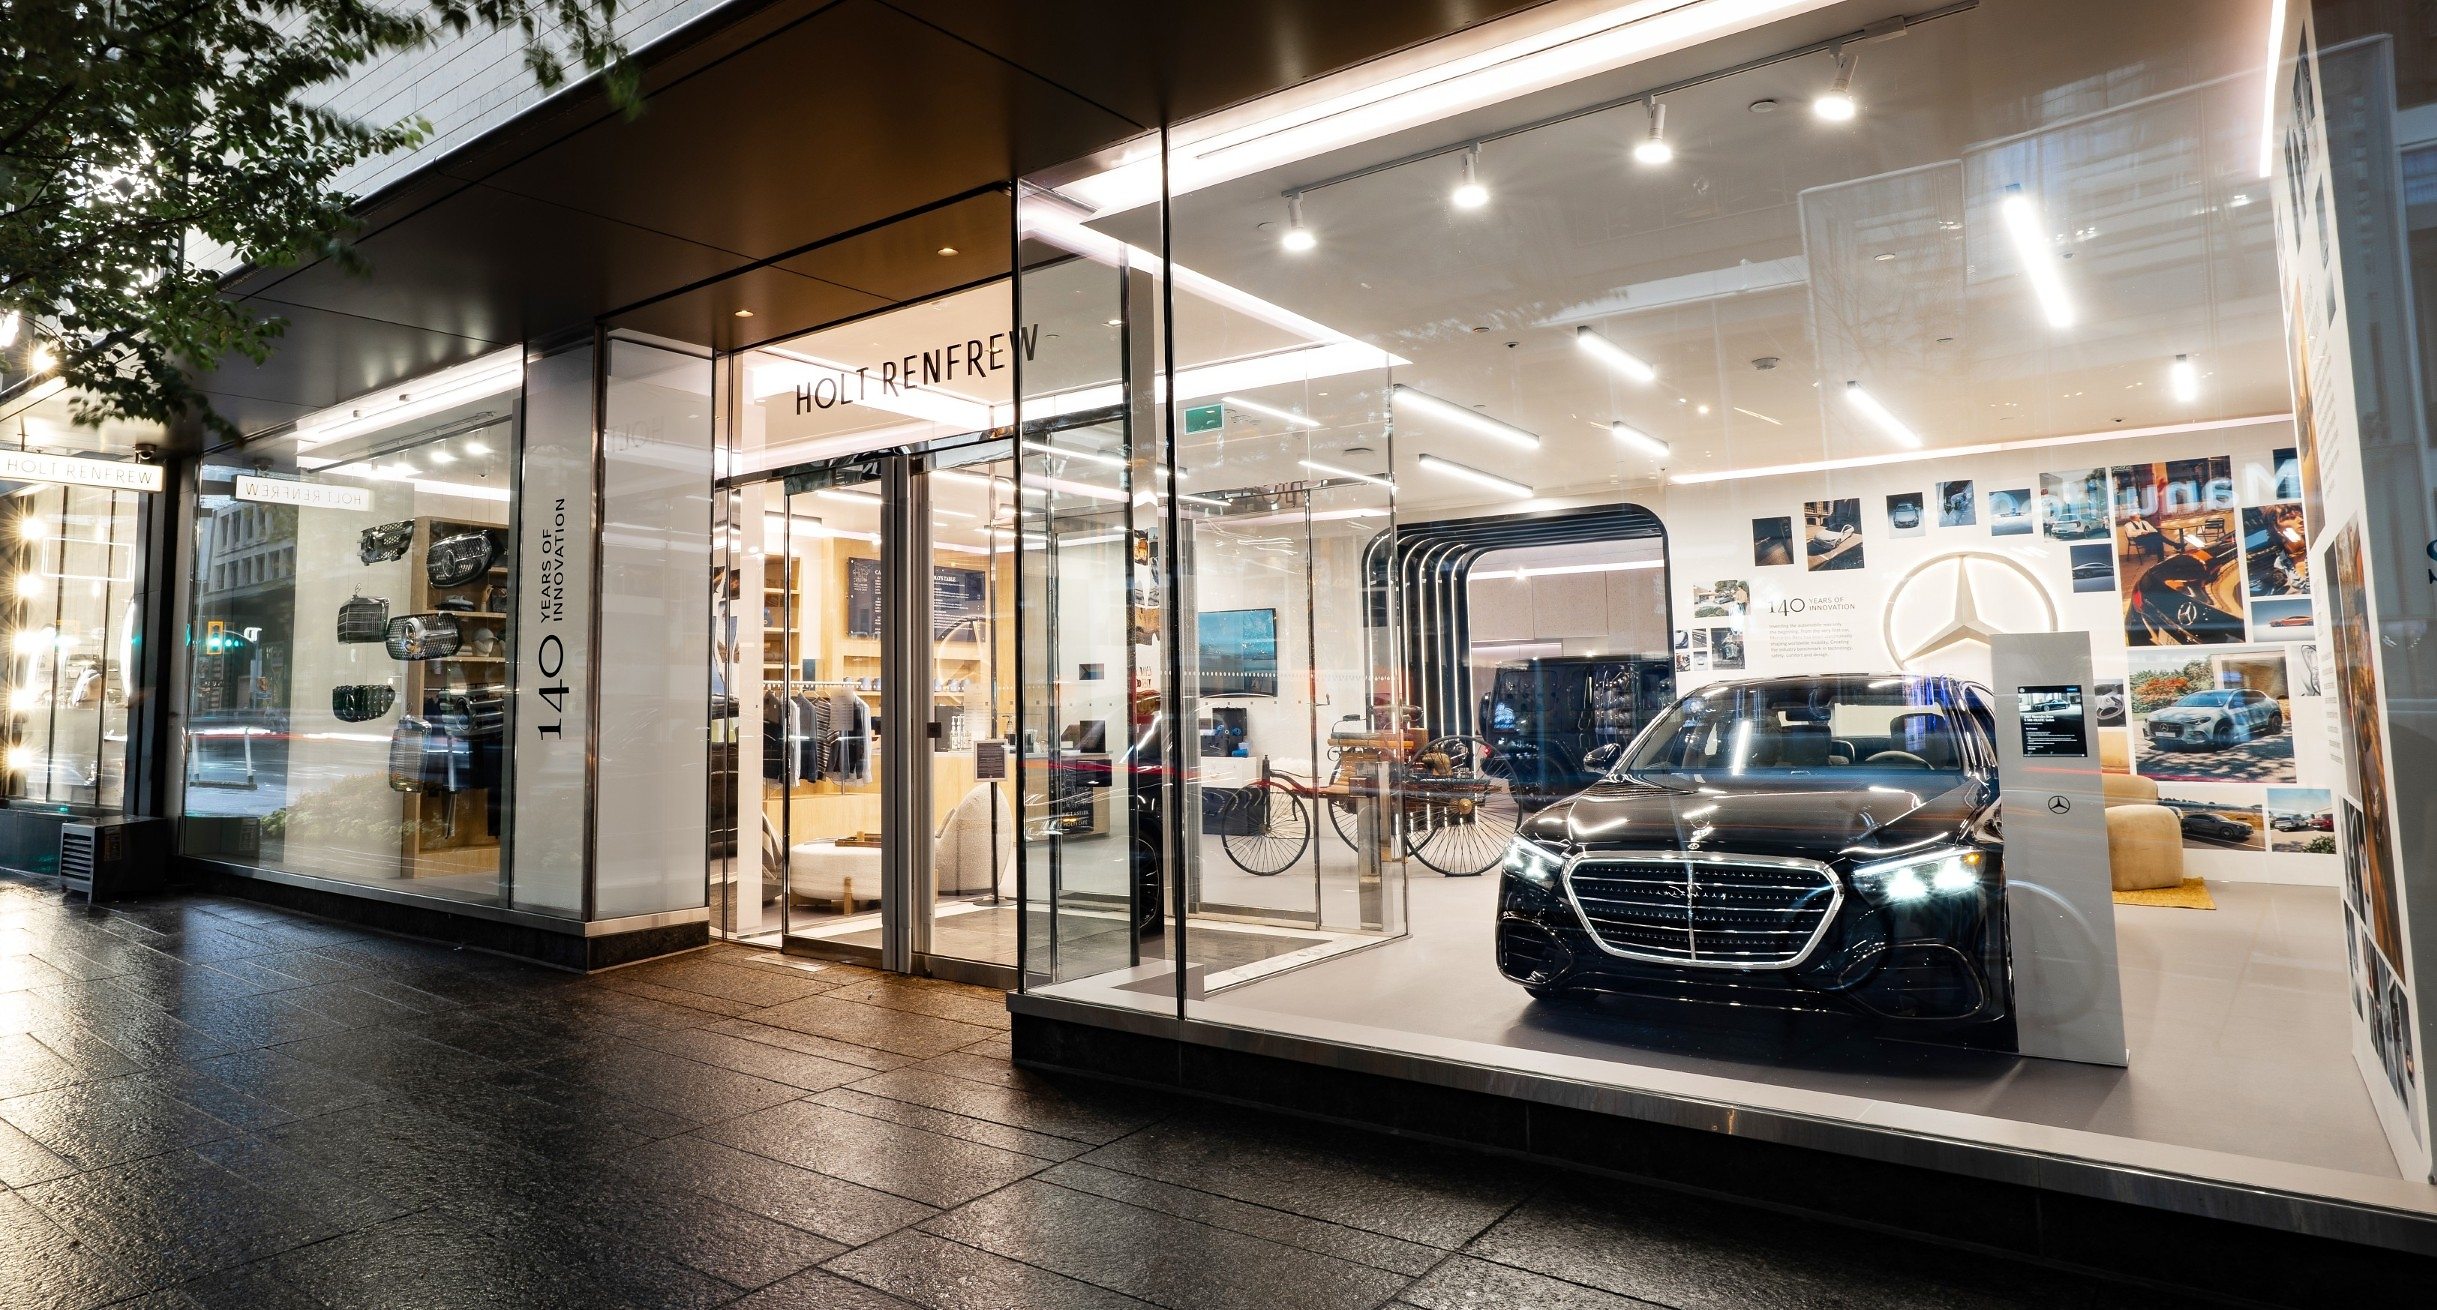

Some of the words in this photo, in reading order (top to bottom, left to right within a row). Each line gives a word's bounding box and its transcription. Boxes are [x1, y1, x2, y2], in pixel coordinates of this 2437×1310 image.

[796, 366, 869, 416] HOLT
[882, 323, 1039, 397] RENFREW
[6, 458, 59, 475] HOLT
[66, 463, 153, 485] RENFREW
[542, 528, 552, 554] OF
[553, 498, 566, 622] INNOVATION
[541, 560, 552, 624] YEARS
[1768, 598, 1806, 616] 140
[1809, 603, 1855, 611] INNOVATION
[537, 634, 570, 741] 140
